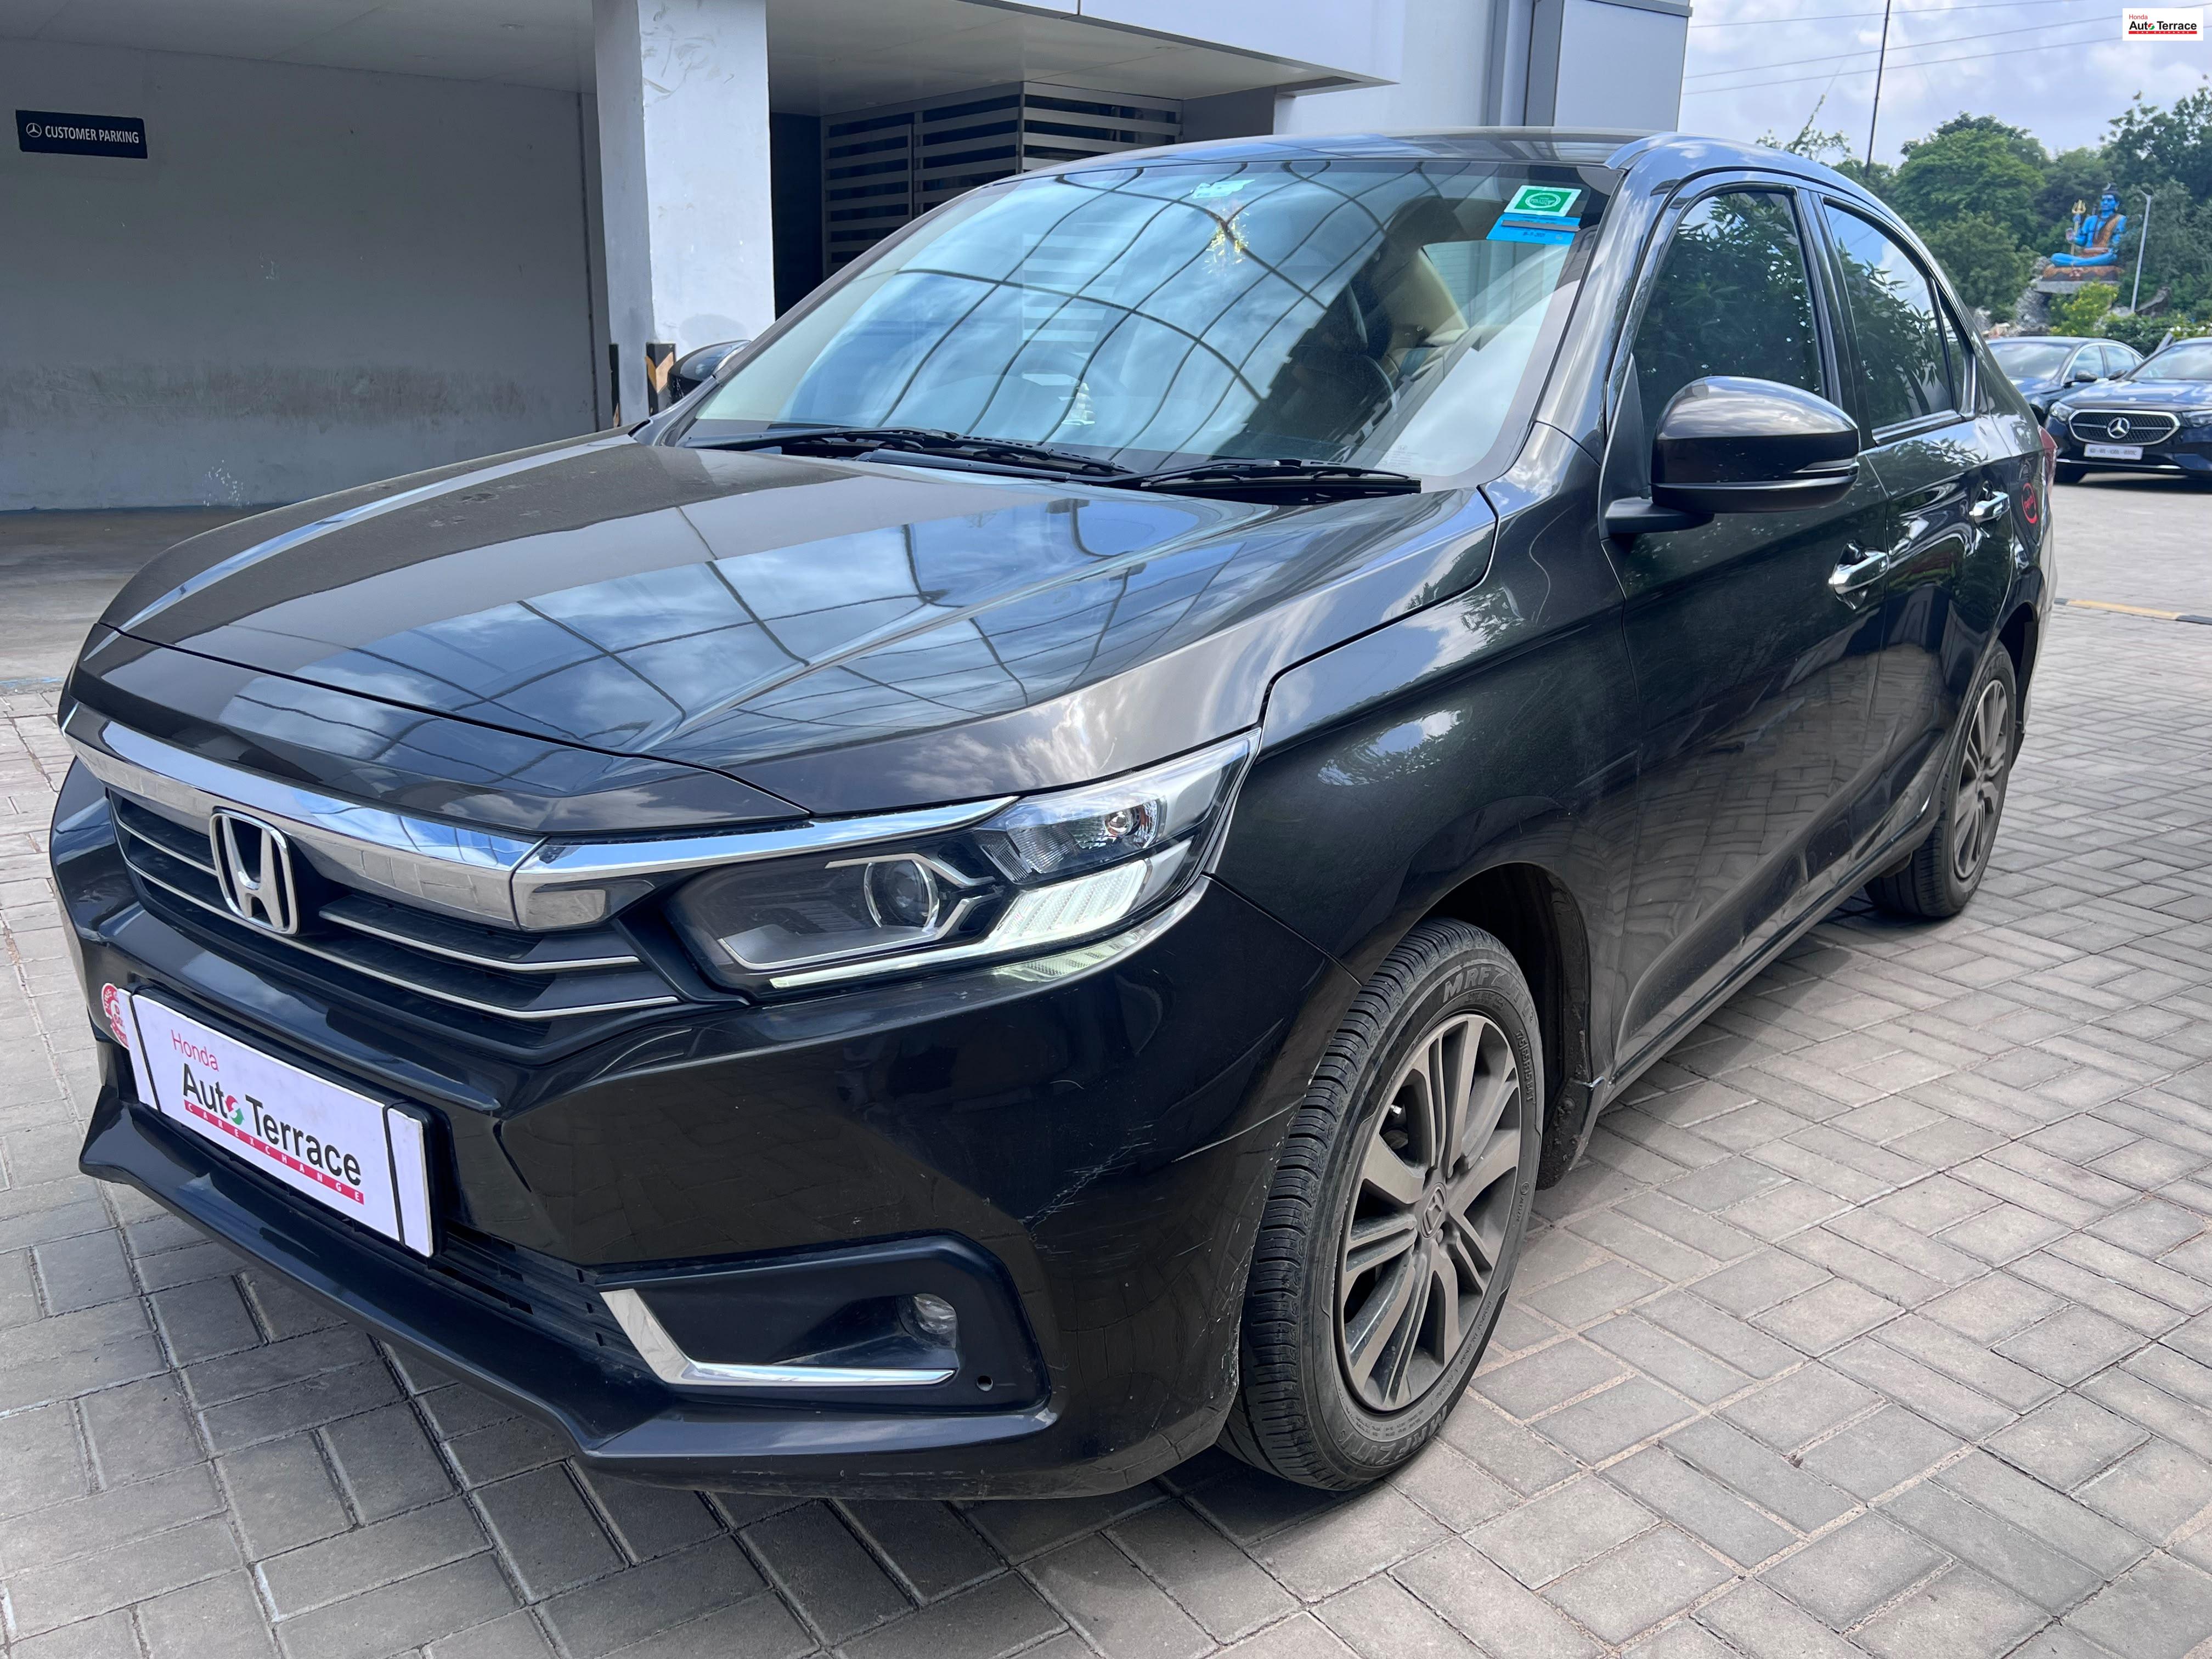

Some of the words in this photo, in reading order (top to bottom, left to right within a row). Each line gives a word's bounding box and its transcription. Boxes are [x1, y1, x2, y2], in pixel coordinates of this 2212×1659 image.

[45, 126, 97, 140] CUSTOMER
[99, 129, 139, 144] PARKING
[1443, 967, 1491, 1003] MRF
[171, 1029, 219, 1072] Honda
[183, 1063, 245, 1125] Auto
[245, 1094, 362, 1186] Terrace
[188, 1103, 224, 1129] CAR
[234, 1128, 360, 1201] EXCHANGE
